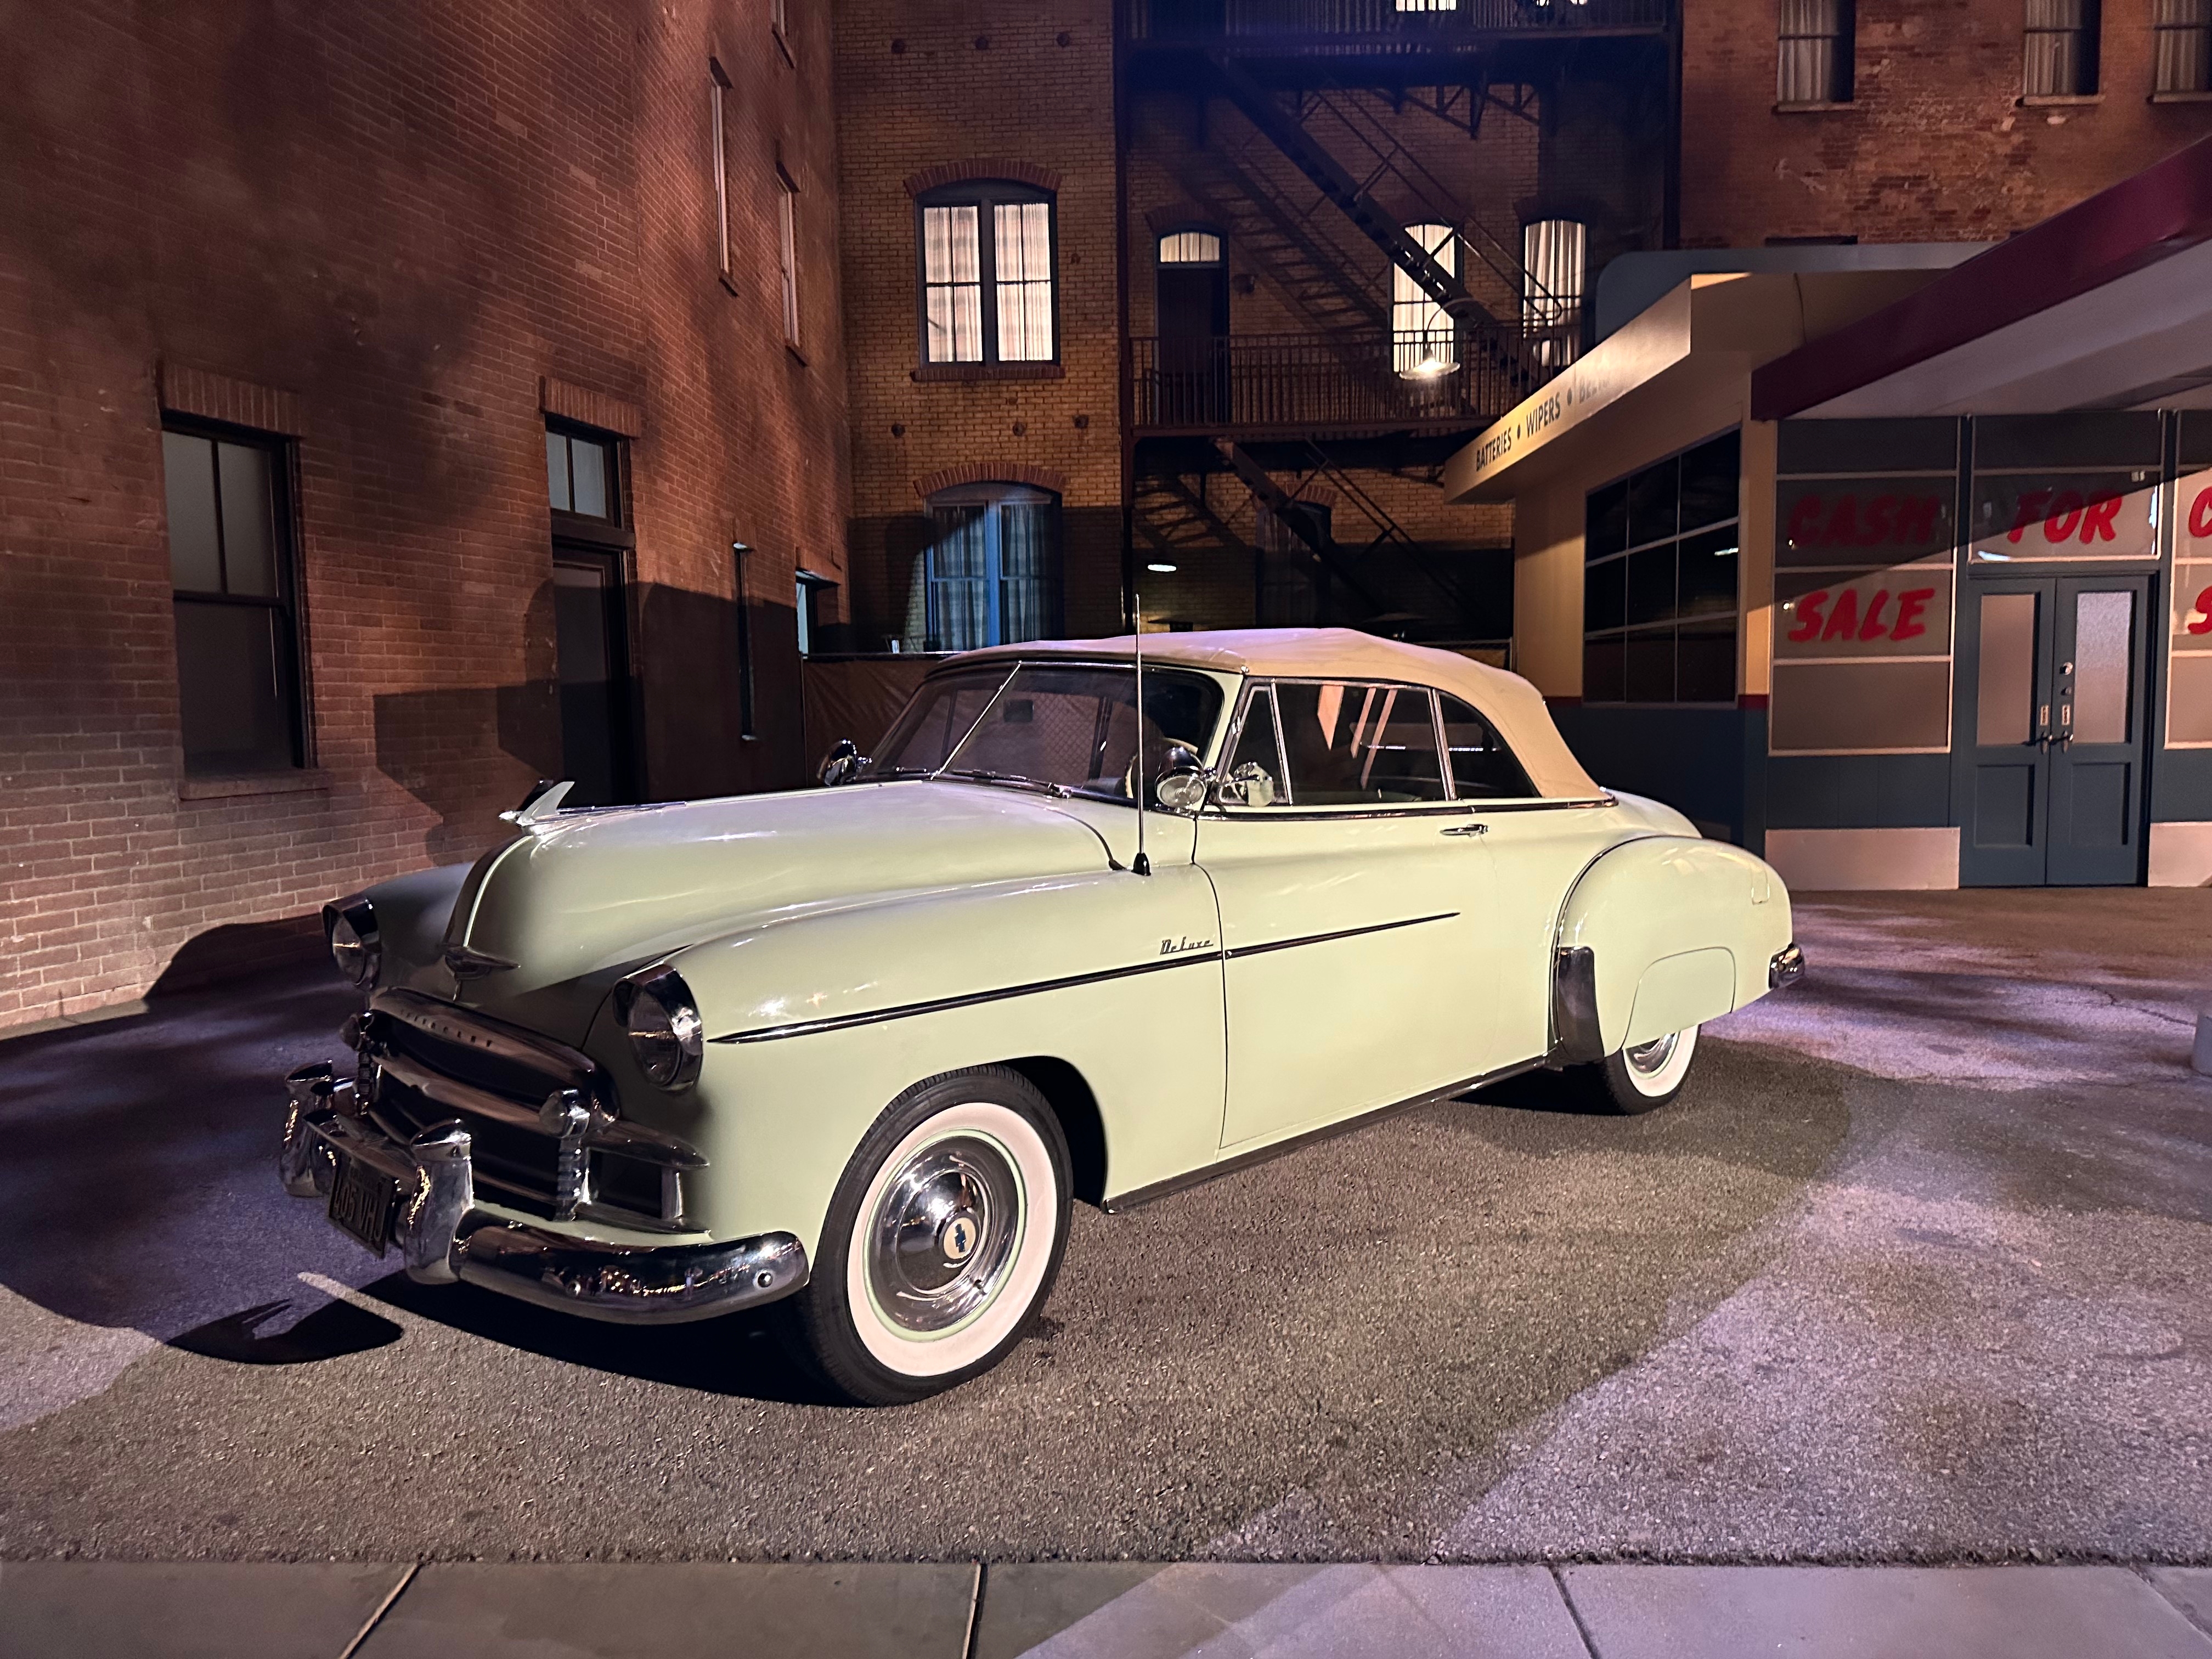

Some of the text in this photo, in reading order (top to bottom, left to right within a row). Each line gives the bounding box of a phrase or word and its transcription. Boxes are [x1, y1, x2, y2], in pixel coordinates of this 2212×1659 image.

[1475, 427, 1512, 472] BATTERIES
[1526, 392, 1561, 438] WIPERS
[1788, 489, 2123, 546] CASH FOR
[1788, 588, 1936, 642] SALE
